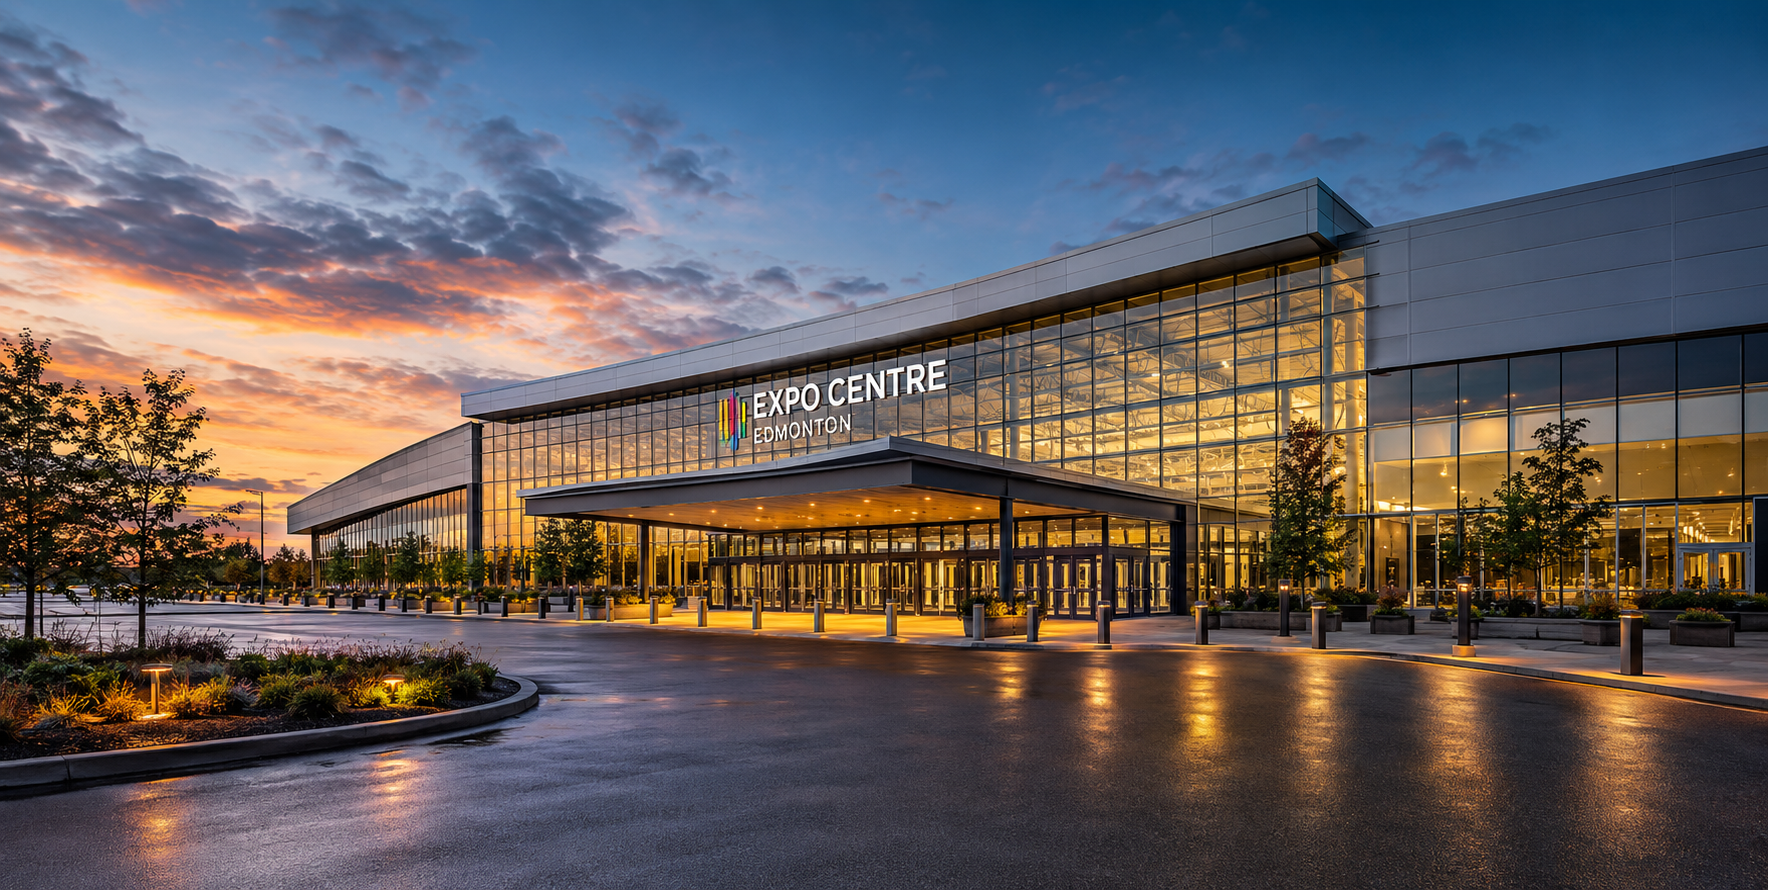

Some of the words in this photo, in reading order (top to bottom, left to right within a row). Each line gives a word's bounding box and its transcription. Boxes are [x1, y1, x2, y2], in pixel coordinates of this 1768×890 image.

[753, 383, 820, 419] EXPO
[828, 359, 947, 407] CENTRE
[754, 414, 852, 444] EDMONTON
